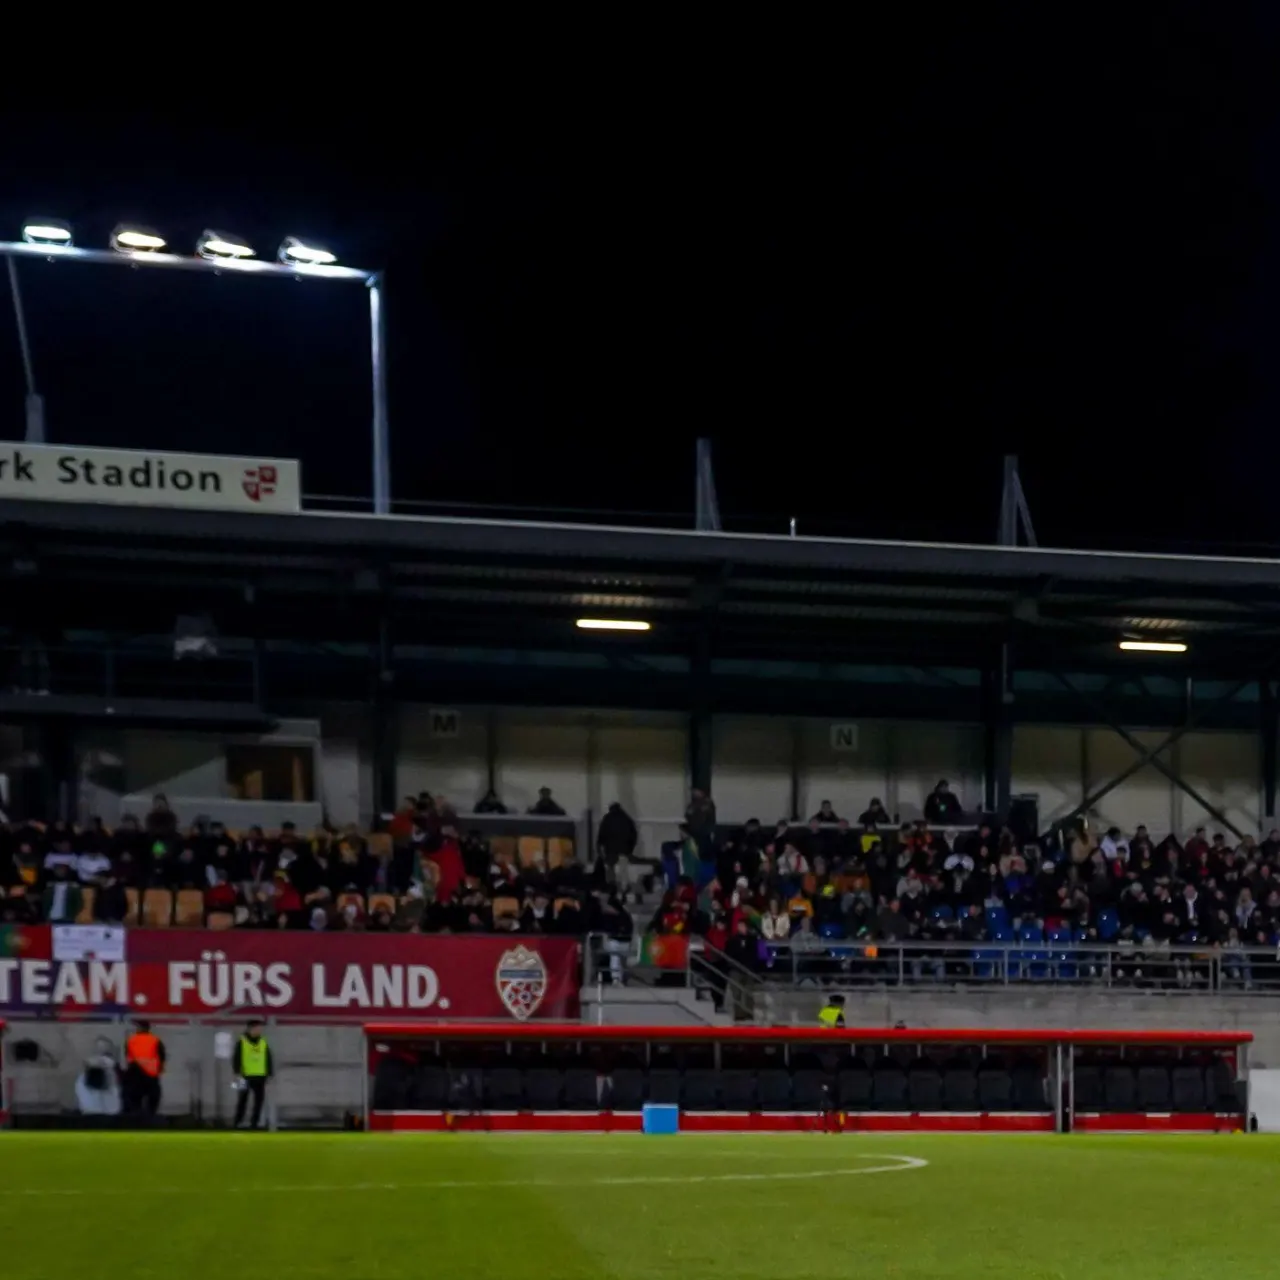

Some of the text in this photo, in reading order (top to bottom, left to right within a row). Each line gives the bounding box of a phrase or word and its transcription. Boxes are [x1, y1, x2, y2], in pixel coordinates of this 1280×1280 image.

[57, 456, 221, 491] Stadion
[433, 714, 456, 732] M
[836, 728, 852, 747] N
[0, 950, 450, 1009] TEAM. FÜRS LAND.
